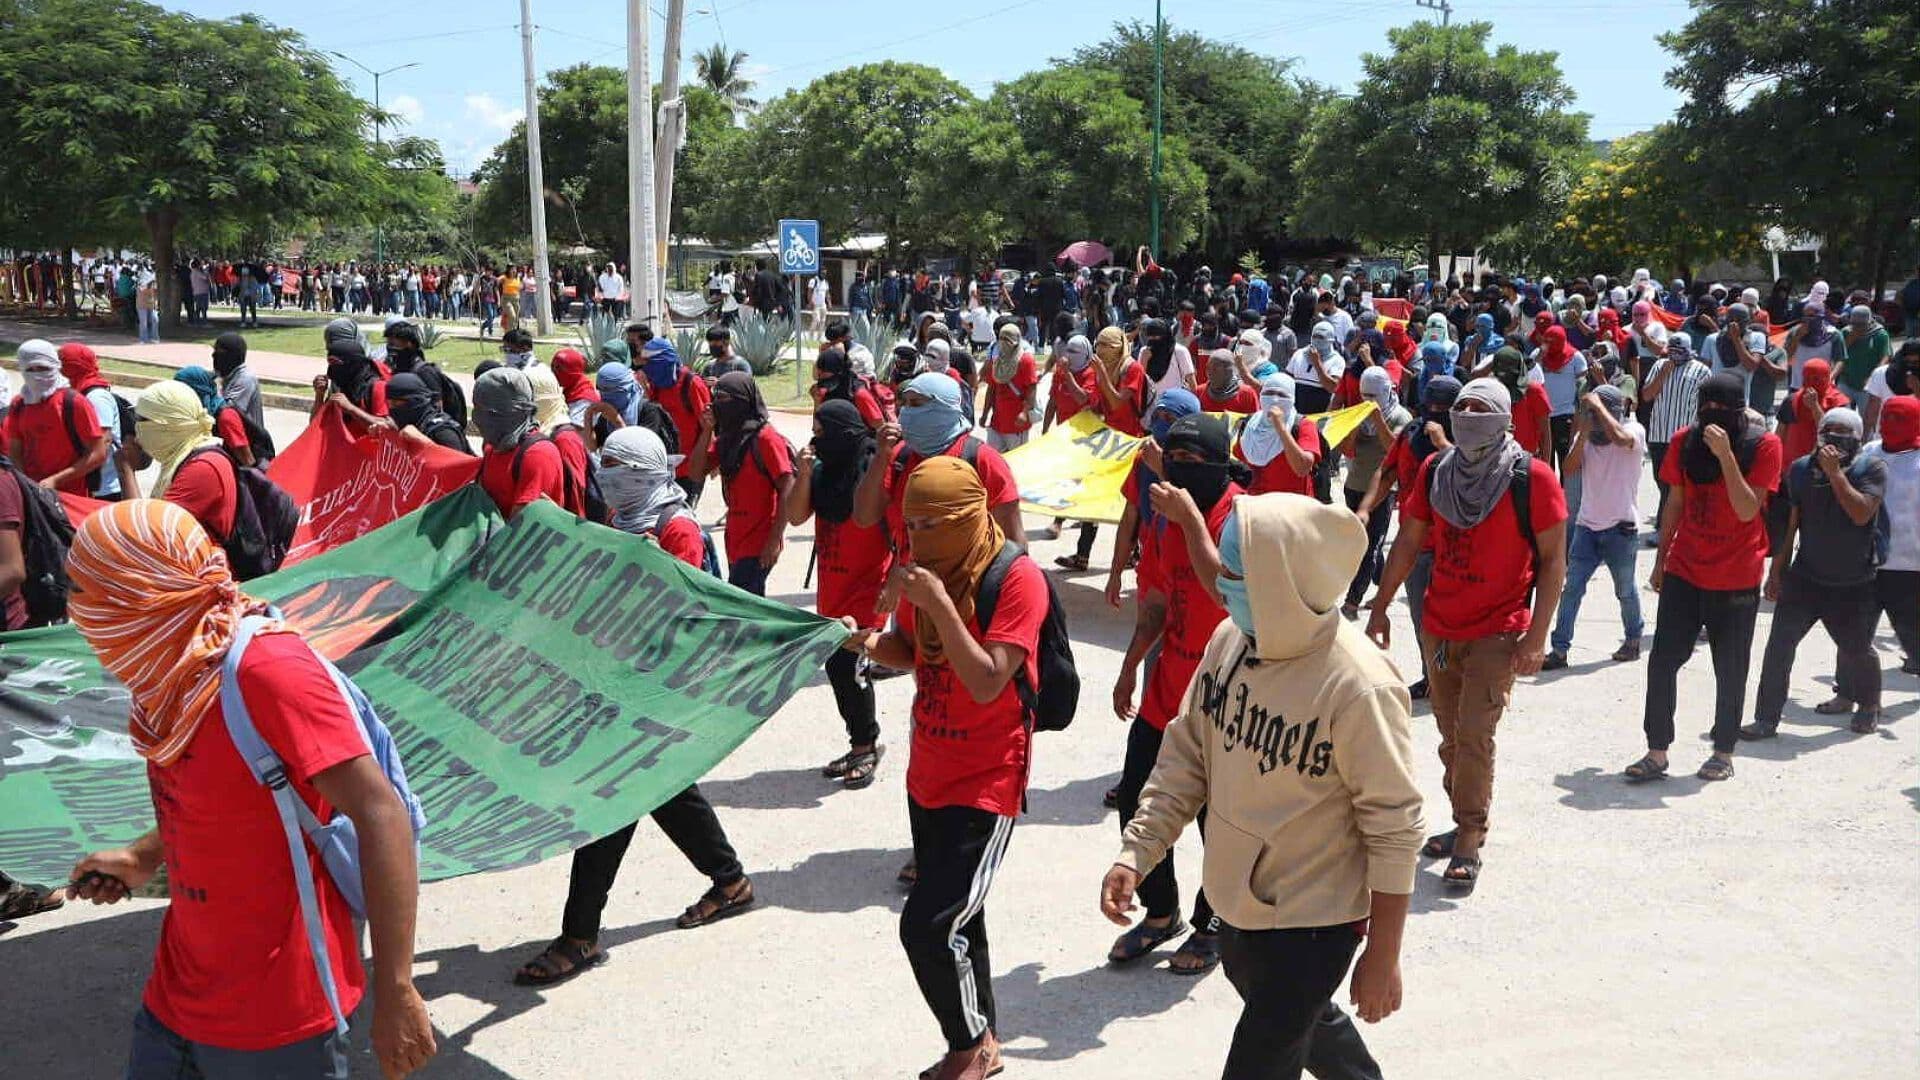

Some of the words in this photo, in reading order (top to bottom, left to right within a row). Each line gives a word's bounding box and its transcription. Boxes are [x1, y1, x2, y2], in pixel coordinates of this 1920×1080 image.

[571, 562, 709, 673] OJOS
[573, 716, 693, 799] TE
[1224, 682, 1333, 778] Angels
